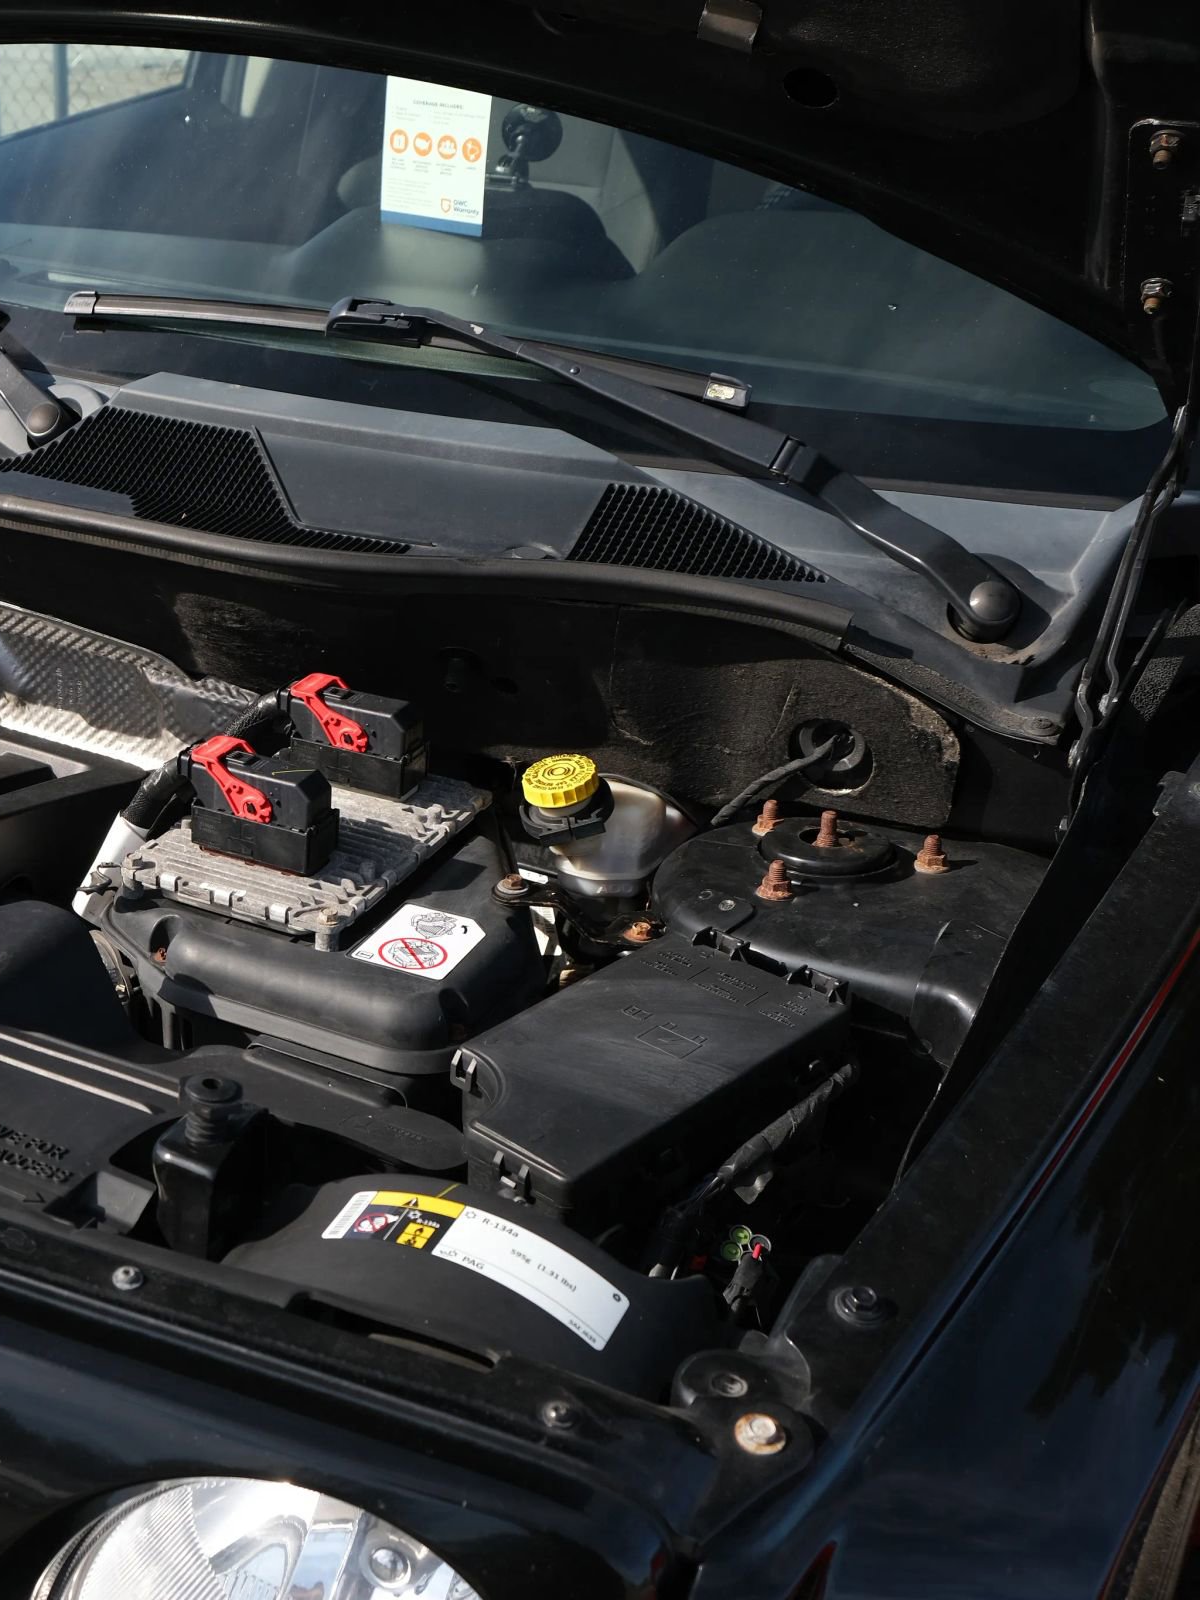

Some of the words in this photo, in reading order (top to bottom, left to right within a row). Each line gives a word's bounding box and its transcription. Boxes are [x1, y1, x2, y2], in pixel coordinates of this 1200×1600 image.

[453, 207, 480, 216] Warranty
[24, 1137, 70, 1161] FOR
[482, 1217, 519, 1238] R-134a
[462, 1255, 486, 1270] PAG
[510, 1248, 532, 1265] 595g
[560, 1275, 578, 1293] lbs)
